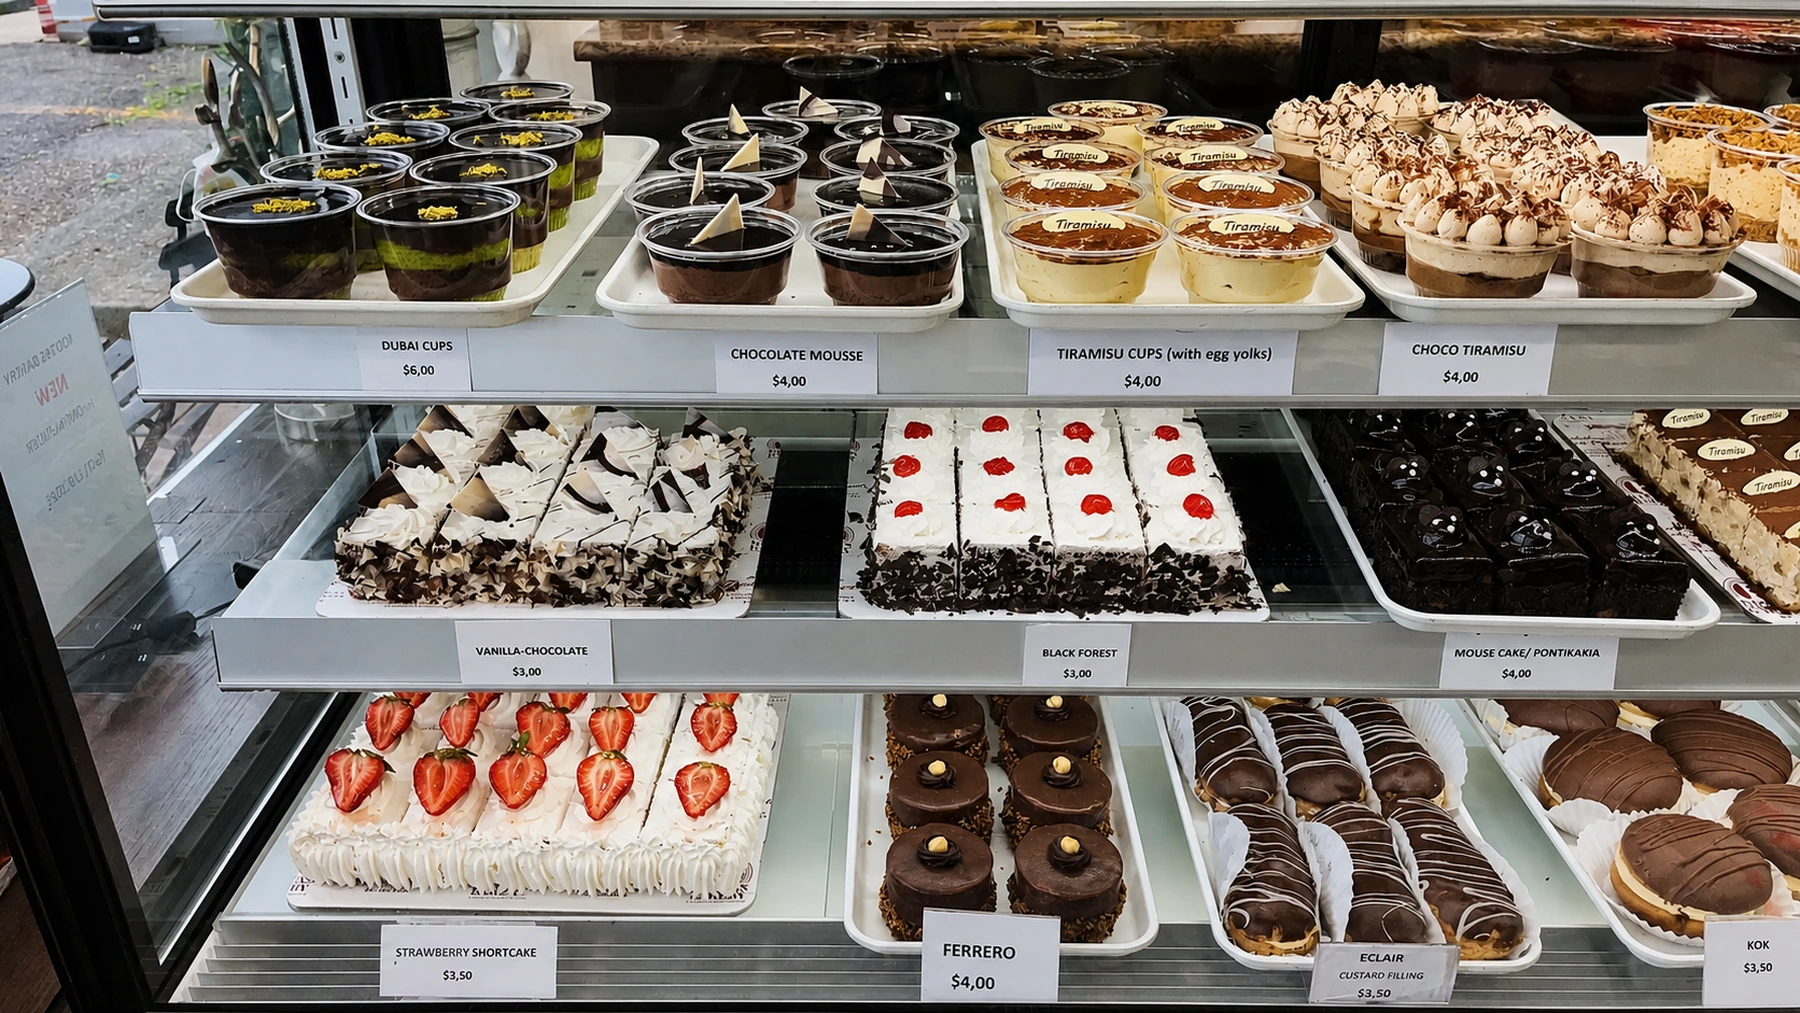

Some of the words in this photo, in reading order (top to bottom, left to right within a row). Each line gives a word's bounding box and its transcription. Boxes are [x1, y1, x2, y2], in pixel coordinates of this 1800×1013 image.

[1190, 151, 1237, 161] Tiramisu
[1056, 219, 1111, 230] Tiramisu
[1223, 221, 1280, 232] Tiramisu
[381, 340, 419, 351] DUBAI
[422, 340, 454, 352] CUPS
[1411, 343, 1460, 356] CHOCO
[1462, 344, 1527, 357] TIRAMISU
[730, 348, 807, 361] CHOCOLATE
[809, 349, 864, 362] MOUSSE
[1056, 347, 1124, 360] TIRAMISU
[1127, 347, 1163, 360] CUPS
[1166, 346, 1202, 363] (with
[1205, 350, 1230, 363] egg
[1232, 346, 1272, 363] yolks)
[402, 363, 435, 378] $6,00
[772, 373, 807, 389] $4,00
[1123, 373, 1162, 390] $4,00
[1442, 369, 1479, 385] $4,00
[1670, 410, 1704, 425] Tiramisu
[1750, 410, 1783, 423] Tiramisu
[1708, 445, 1747, 457] Tiramisu
[1754, 477, 1794, 492] Tiramisu
[475, 646, 589, 656] VANILLA-CHOCOLATE
[1042, 648, 1076, 658] BLACK
[1077, 648, 1119, 658] FOREST
[1454, 648, 1496, 658] MOUSE
[1497, 647, 1532, 660] CAKE/
[1533, 648, 1600, 658] PONTIKAKIA
[512, 666, 542, 678] $3,00
[1063, 668, 1092, 680] $3,00
[1501, 668, 1532, 680] $4,00
[943, 943, 1016, 960] FERRERO
[1747, 940, 1770, 951] KOK
[395, 947, 470, 958] STRAWBERRY
[471, 947, 537, 958] SHORTCAKE
[1359, 953, 1405, 963] ECLAIR
[1743, 962, 1773, 975] $3,50
[442, 969, 473, 982] $3,50
[1338, 971, 1385, 981] CUSTARD
[1387, 971, 1425, 981] FILLING
[950, 972, 996, 992] $4,00
[1357, 988, 1392, 999] $3,50
